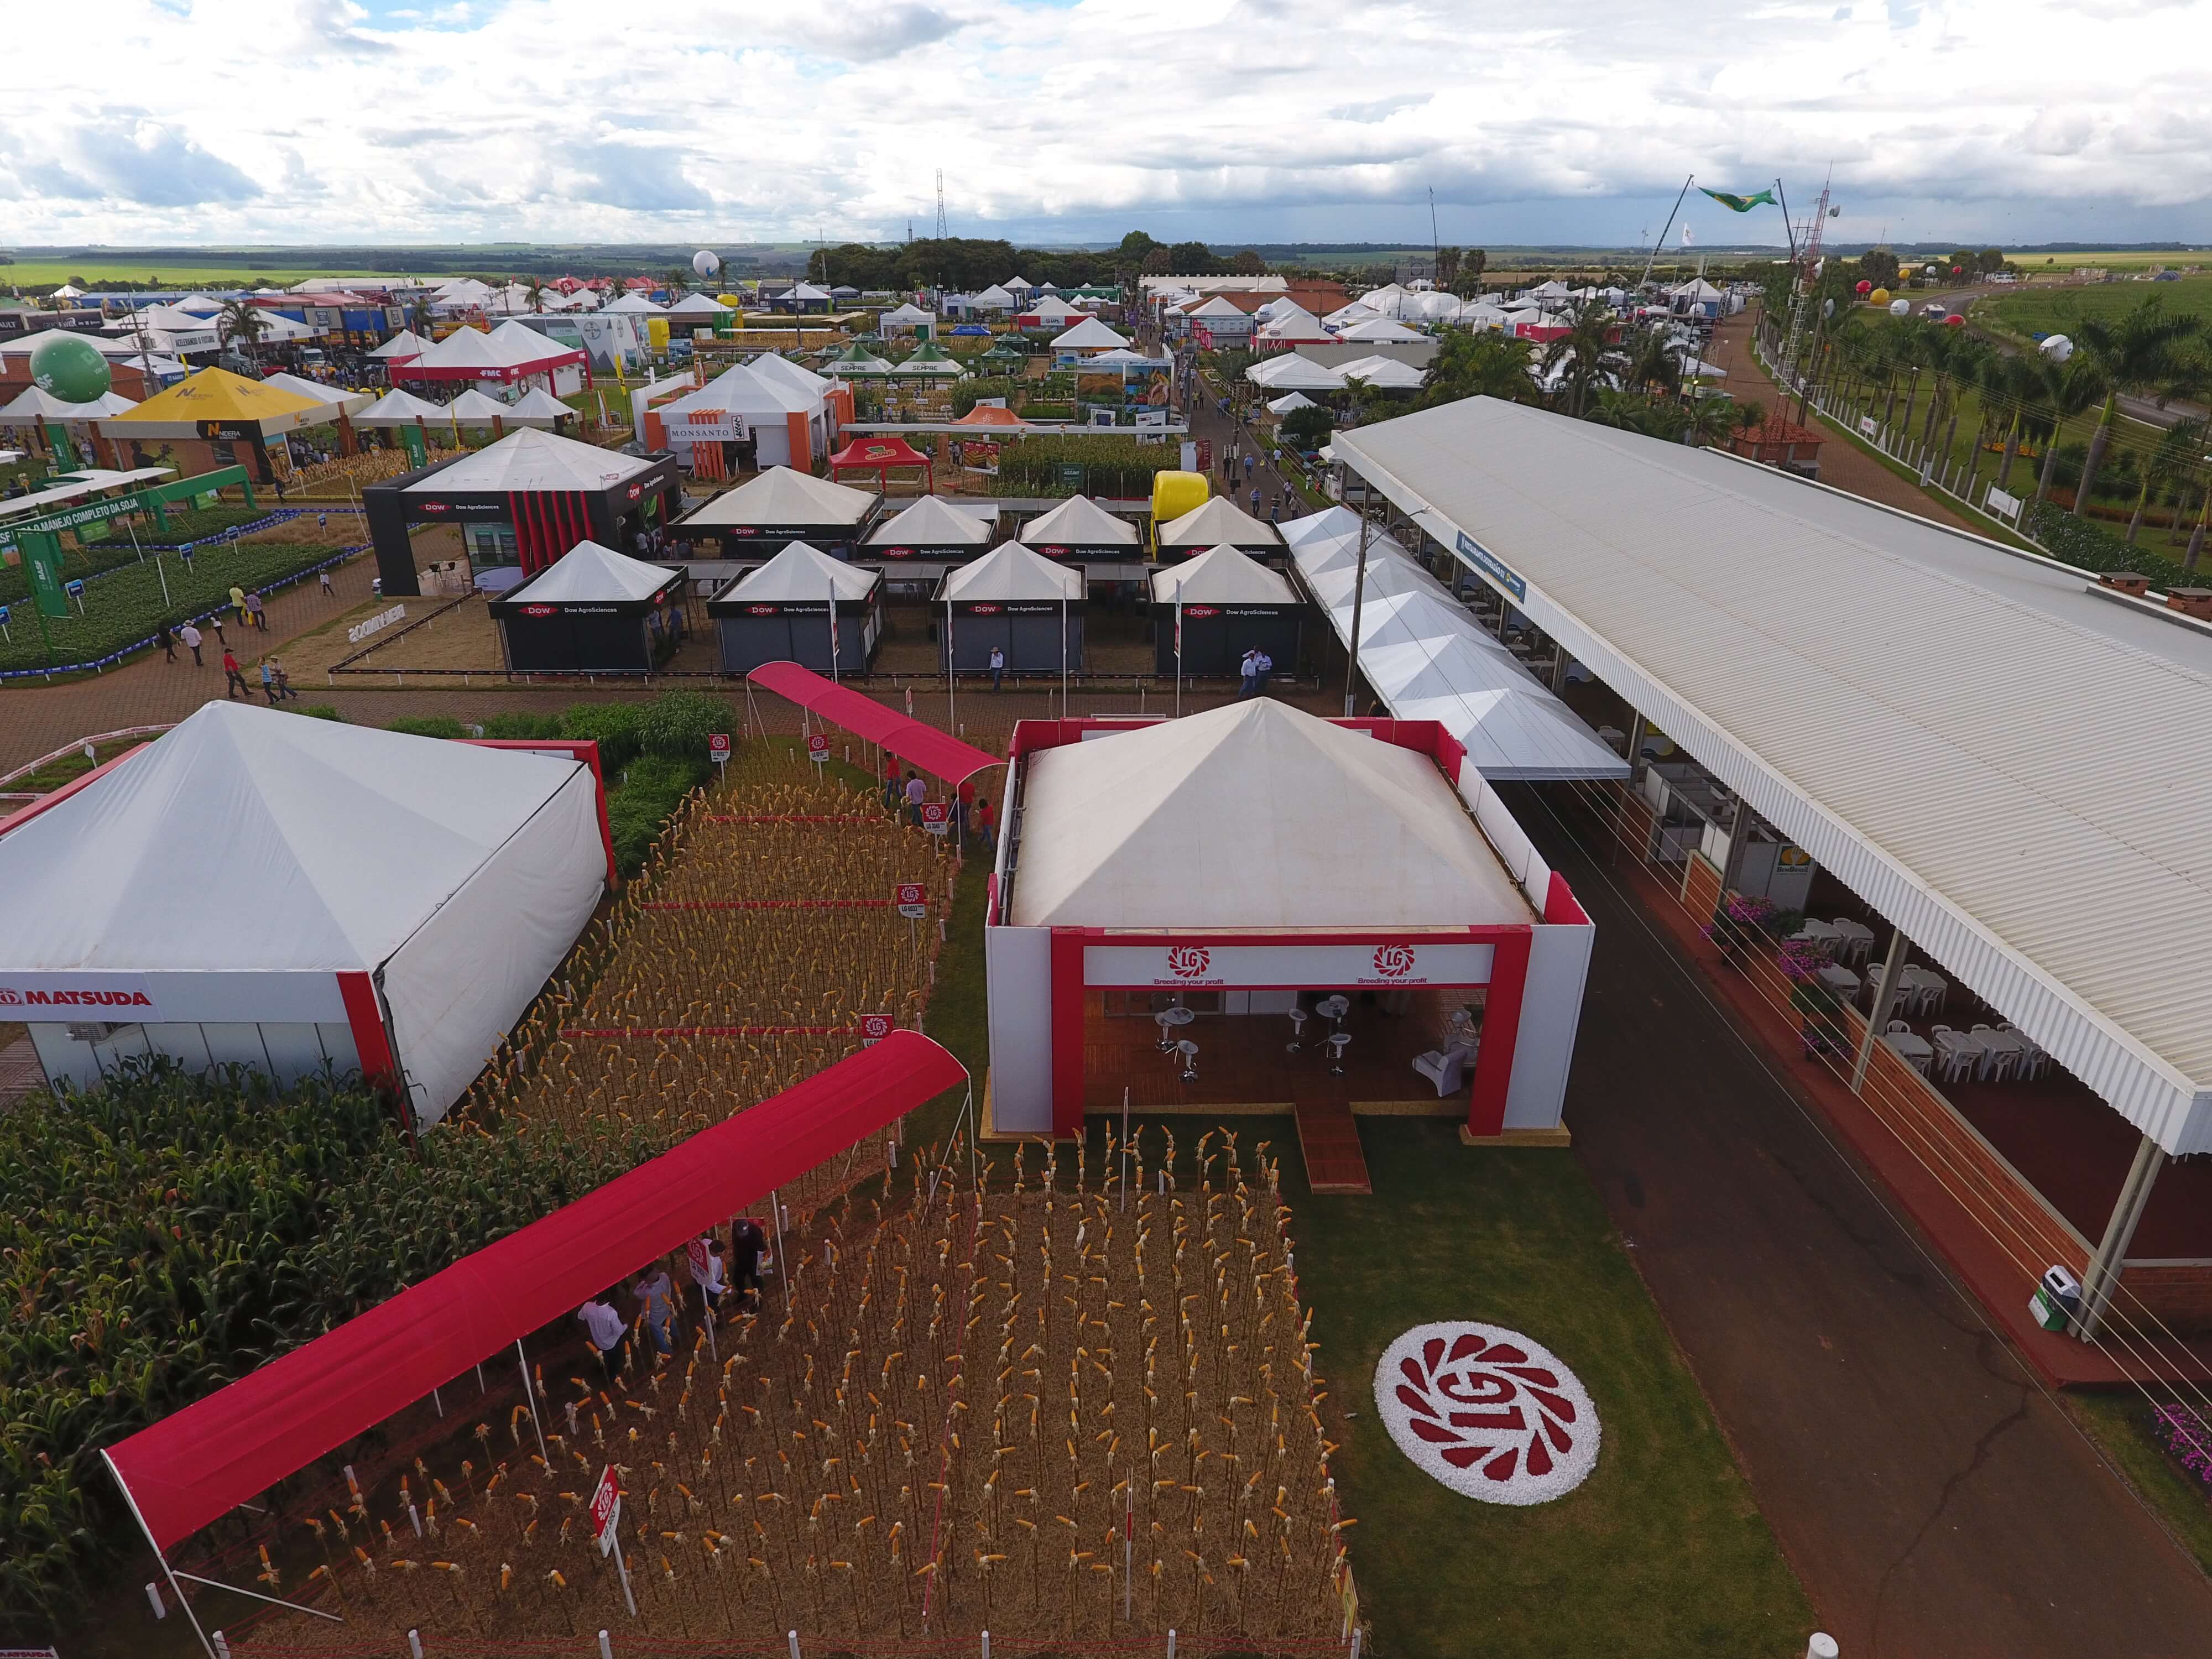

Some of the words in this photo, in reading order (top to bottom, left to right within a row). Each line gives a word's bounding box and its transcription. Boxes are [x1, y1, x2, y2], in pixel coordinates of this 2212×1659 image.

[40, 517, 72, 531] MANEJO
[72, 507, 109, 524] COMPLETO
[110, 503, 120, 514] DA
[120, 498, 138, 510] SOJA
[1181, 951, 1197, 967] LG
[1386, 951, 1403, 966] LG
[25, 990, 152, 1005] MATSUDA
[872, 1022, 881, 1031] LG
[1437, 1371, 1527, 1430] LG
